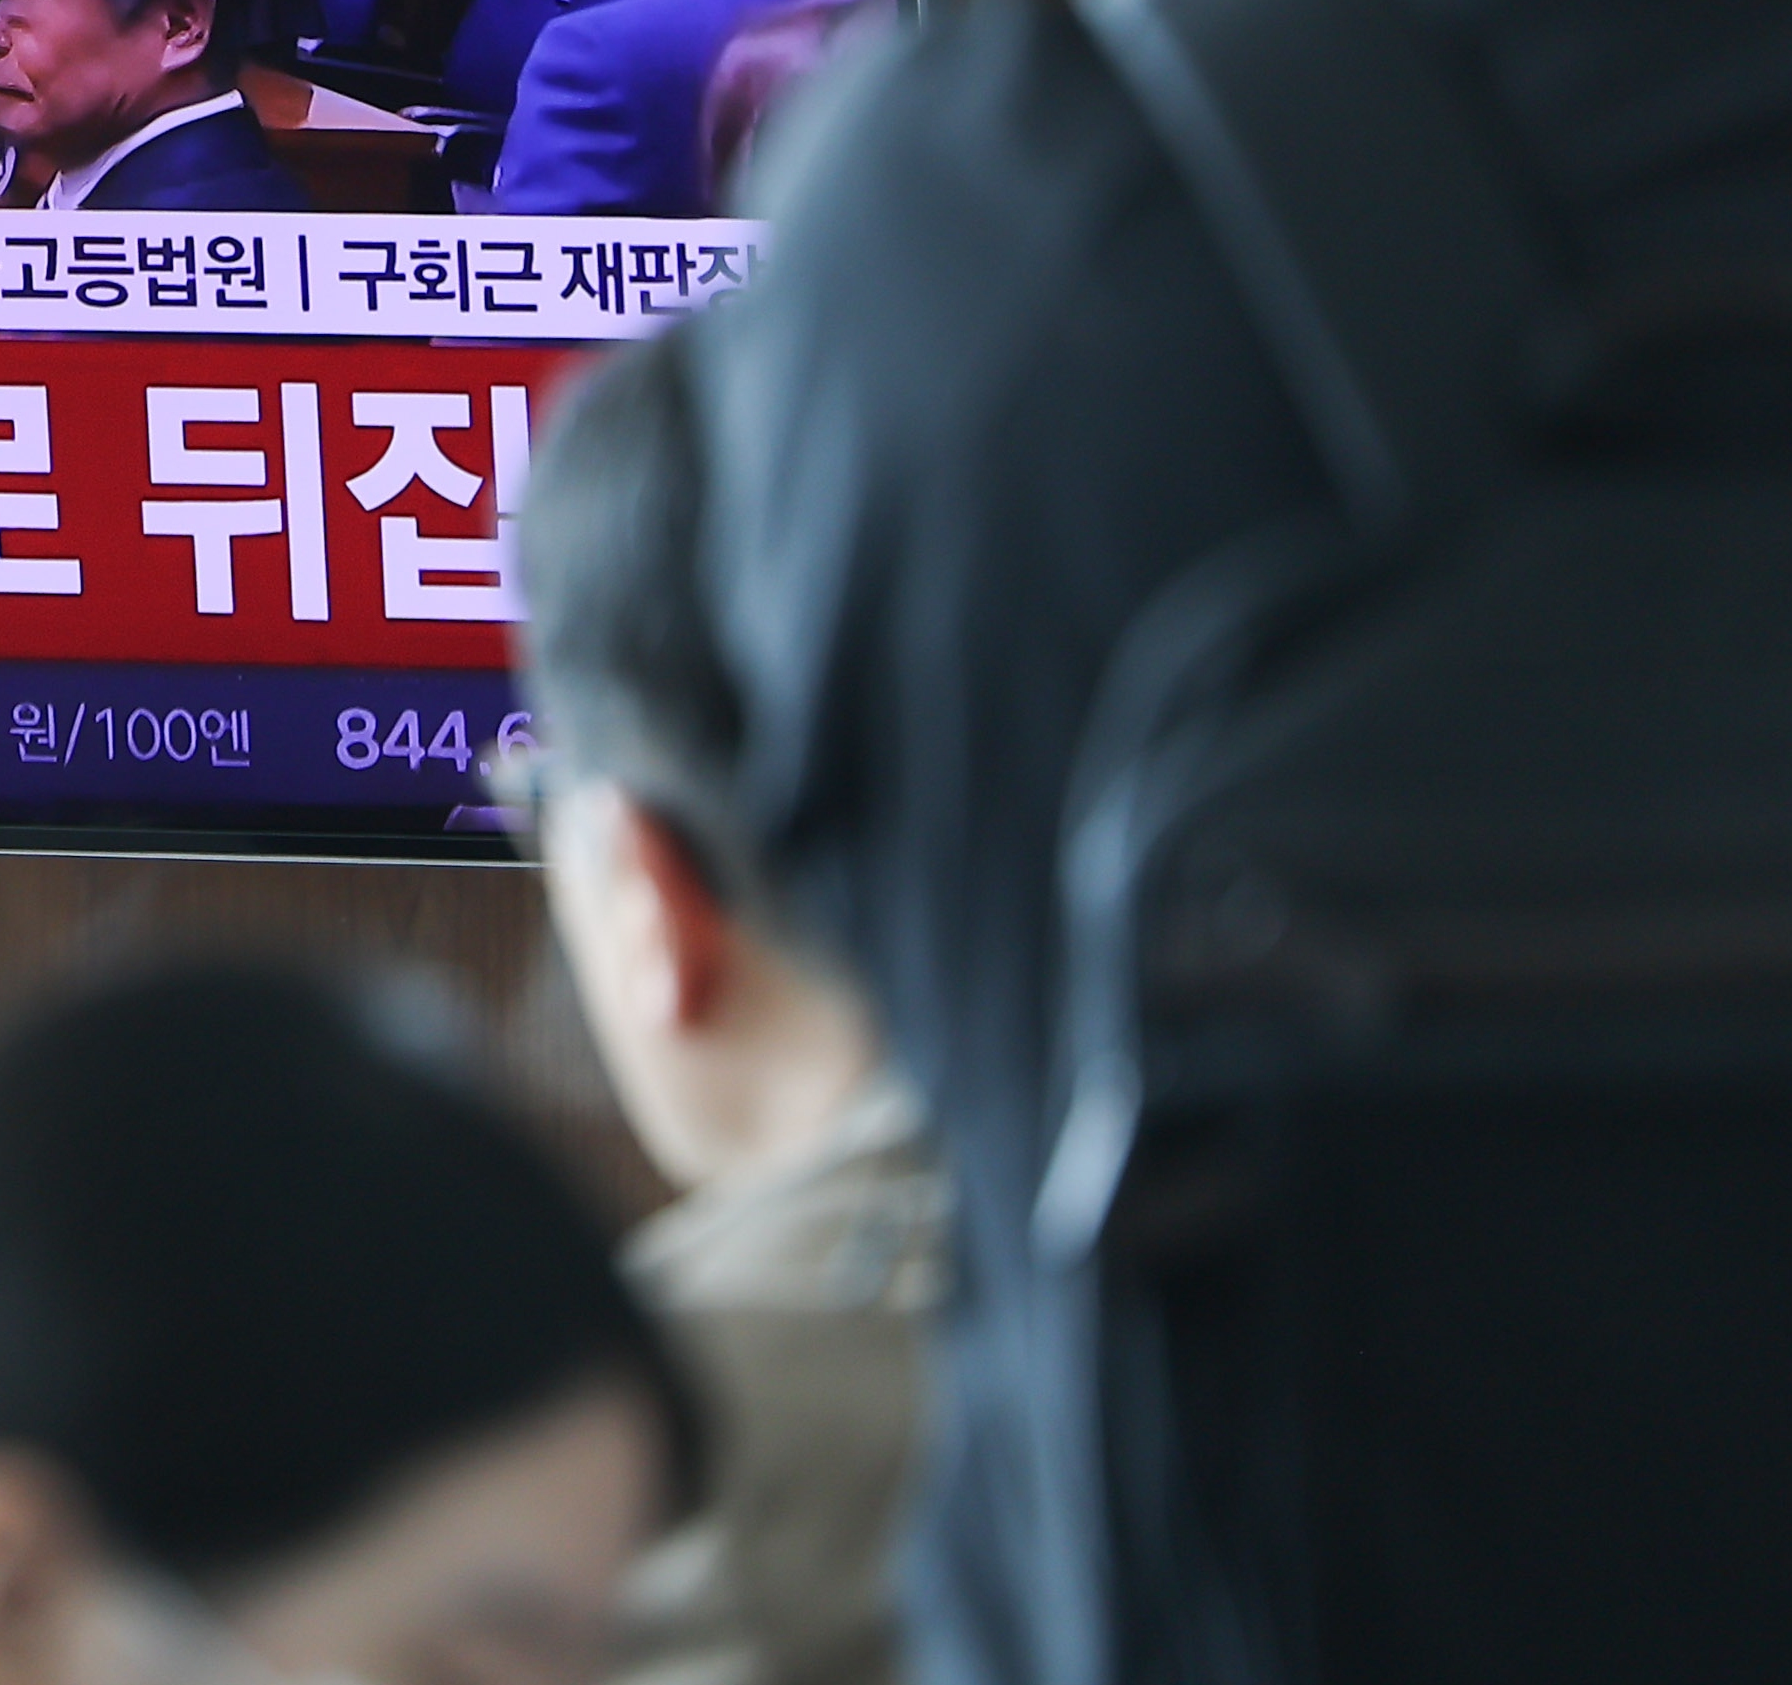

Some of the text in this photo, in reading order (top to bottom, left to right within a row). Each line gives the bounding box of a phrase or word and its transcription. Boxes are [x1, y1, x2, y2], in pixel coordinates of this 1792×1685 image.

[339, 240, 542, 312] 구회근
[142, 383, 531, 621] 뒤집
[10, 703, 249, 766] 원/100엔
